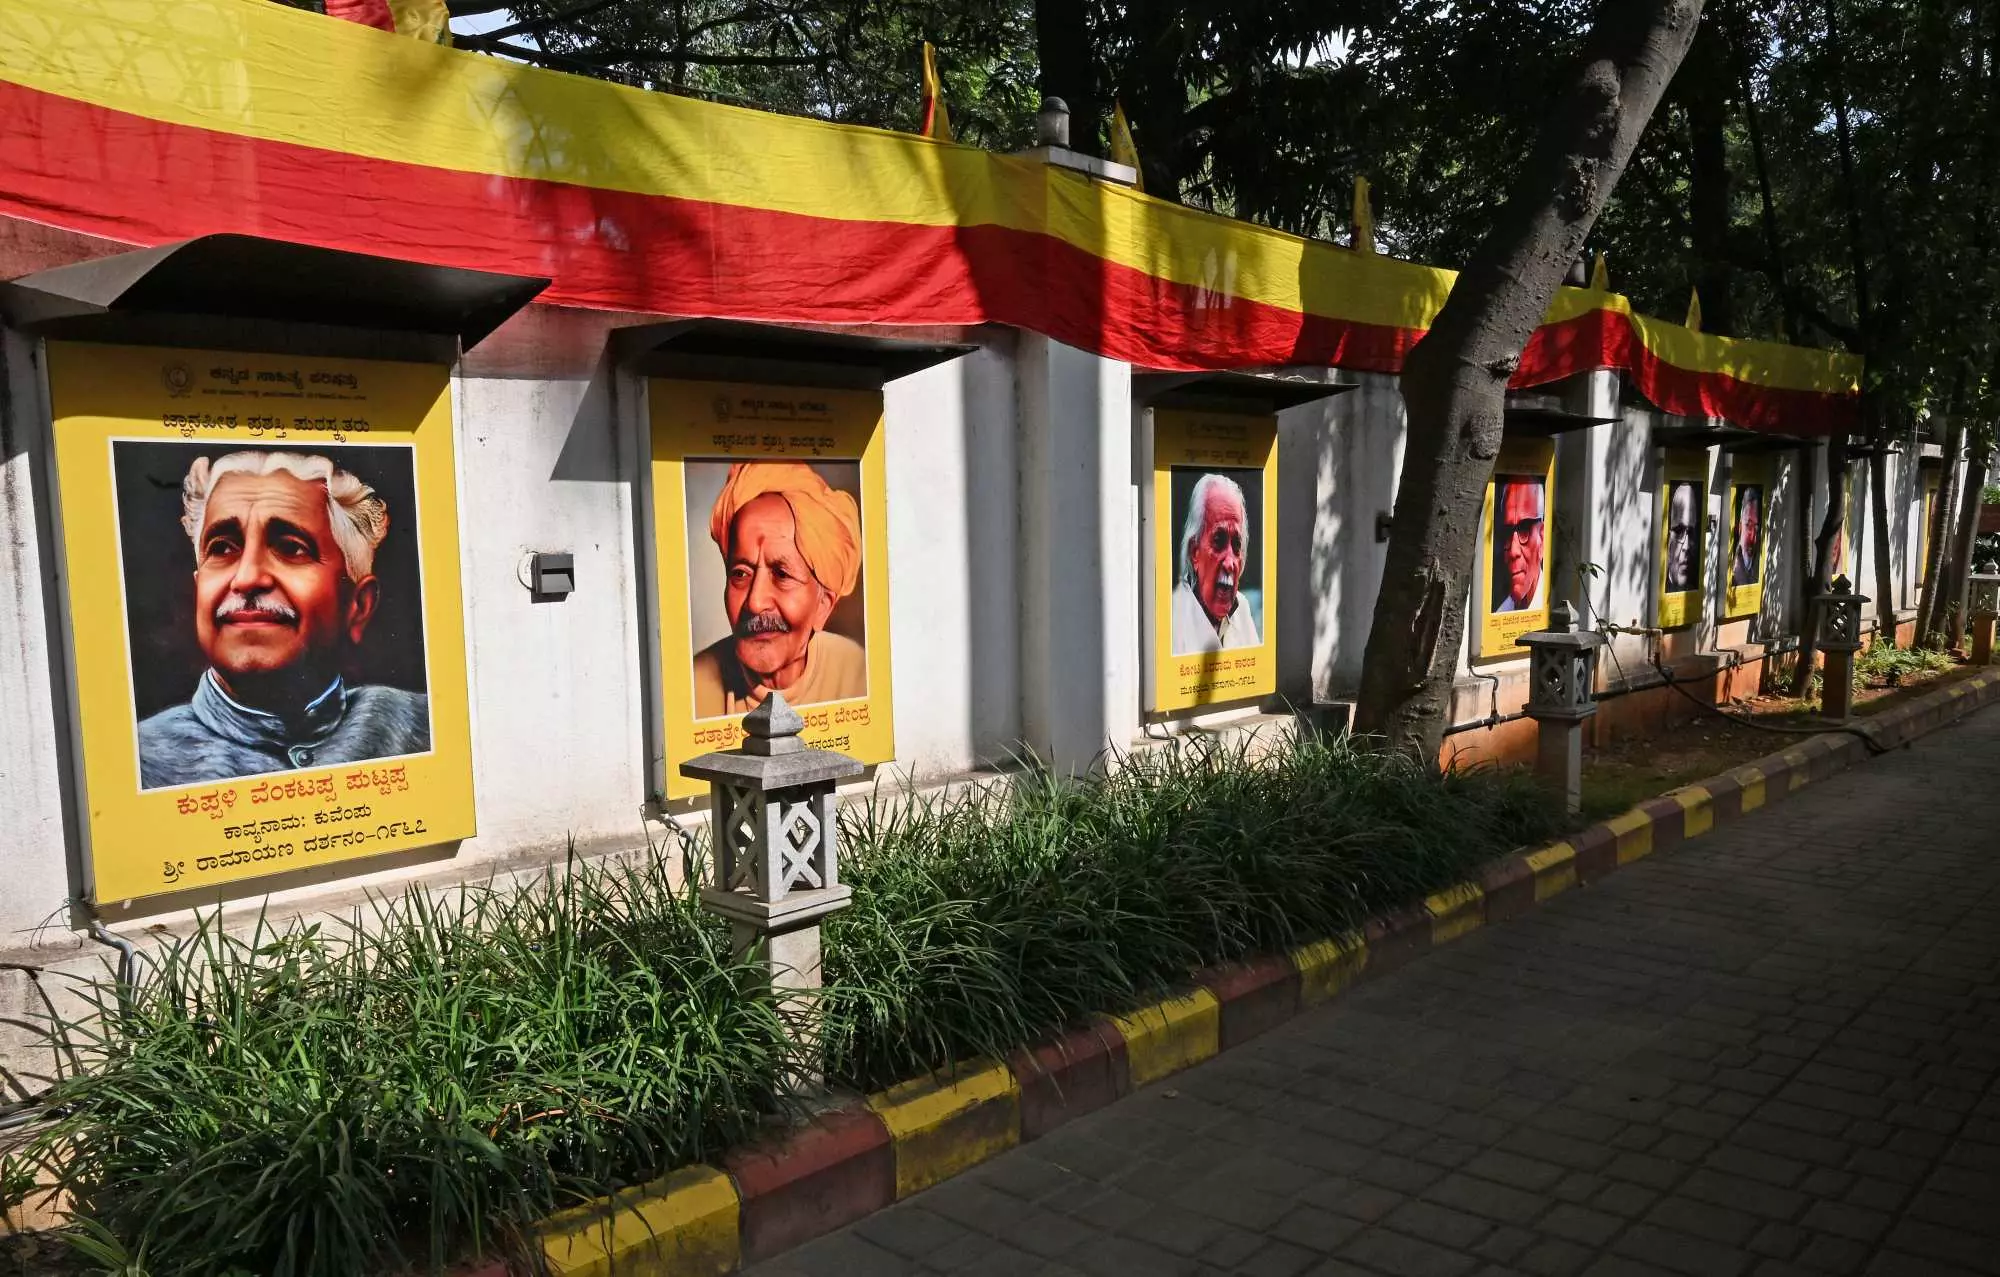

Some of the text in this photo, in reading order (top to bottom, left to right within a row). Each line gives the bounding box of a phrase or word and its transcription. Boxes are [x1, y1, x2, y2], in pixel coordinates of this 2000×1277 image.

[209, 367, 249, 385] ಕನ್ನಡ
[256, 369, 304, 389] ಸಾಹಿತ್ಯ
[162, 413, 370, 443] ಜ್ಞಾನಪೀಠ ಪ್ರಶಸ್ತಿ ಪುರಸ್ಕೃತರು
[835, 703, 871, 726] ಬೇಂದ್ರೆ
[176, 762, 409, 820] ಕುಪ್ಪಳಿ ವೆಂಕಟಪ್ಪ ಪುಟ್ಟಪ್ಪ
[223, 802, 372, 844] ಕಾವ್ಯನಾಮ: ಕುವೆಂಪು
[162, 859, 185, 883] ಶ್ರೀ
[196, 840, 294, 872] ರಾಮಾಯಣ
